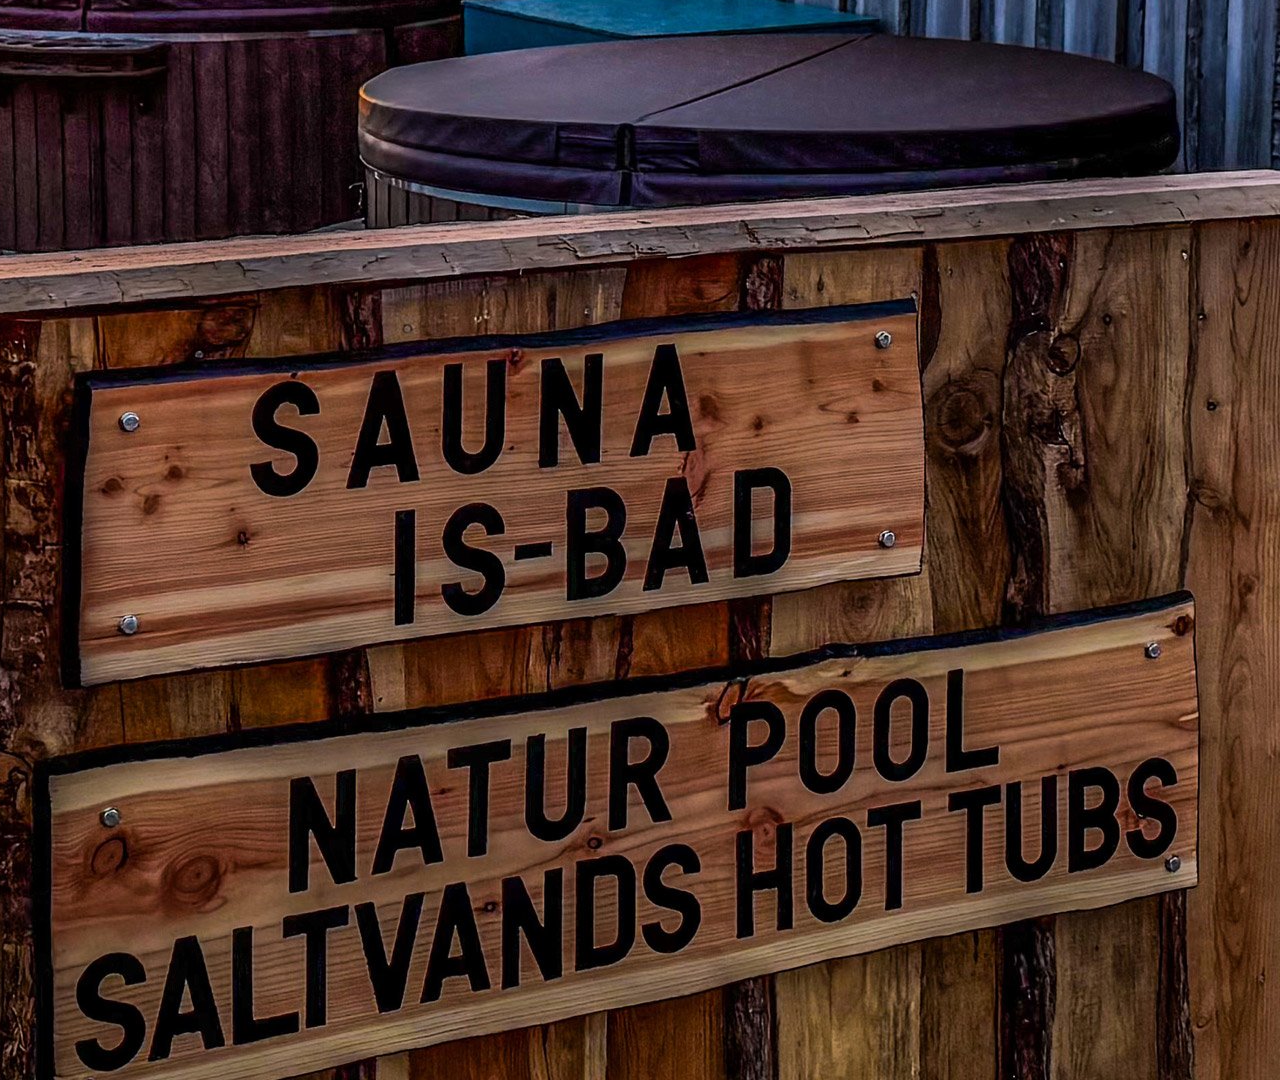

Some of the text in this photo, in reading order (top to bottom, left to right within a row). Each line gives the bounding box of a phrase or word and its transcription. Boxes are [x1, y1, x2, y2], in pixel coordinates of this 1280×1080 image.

[249, 342, 697, 497] SAUNA
[390, 466, 793, 626] IS-BAD
[288, 667, 1000, 894] NATUR POOL
[74, 756, 1179, 1072] SALTVANDS HOT TUBS
